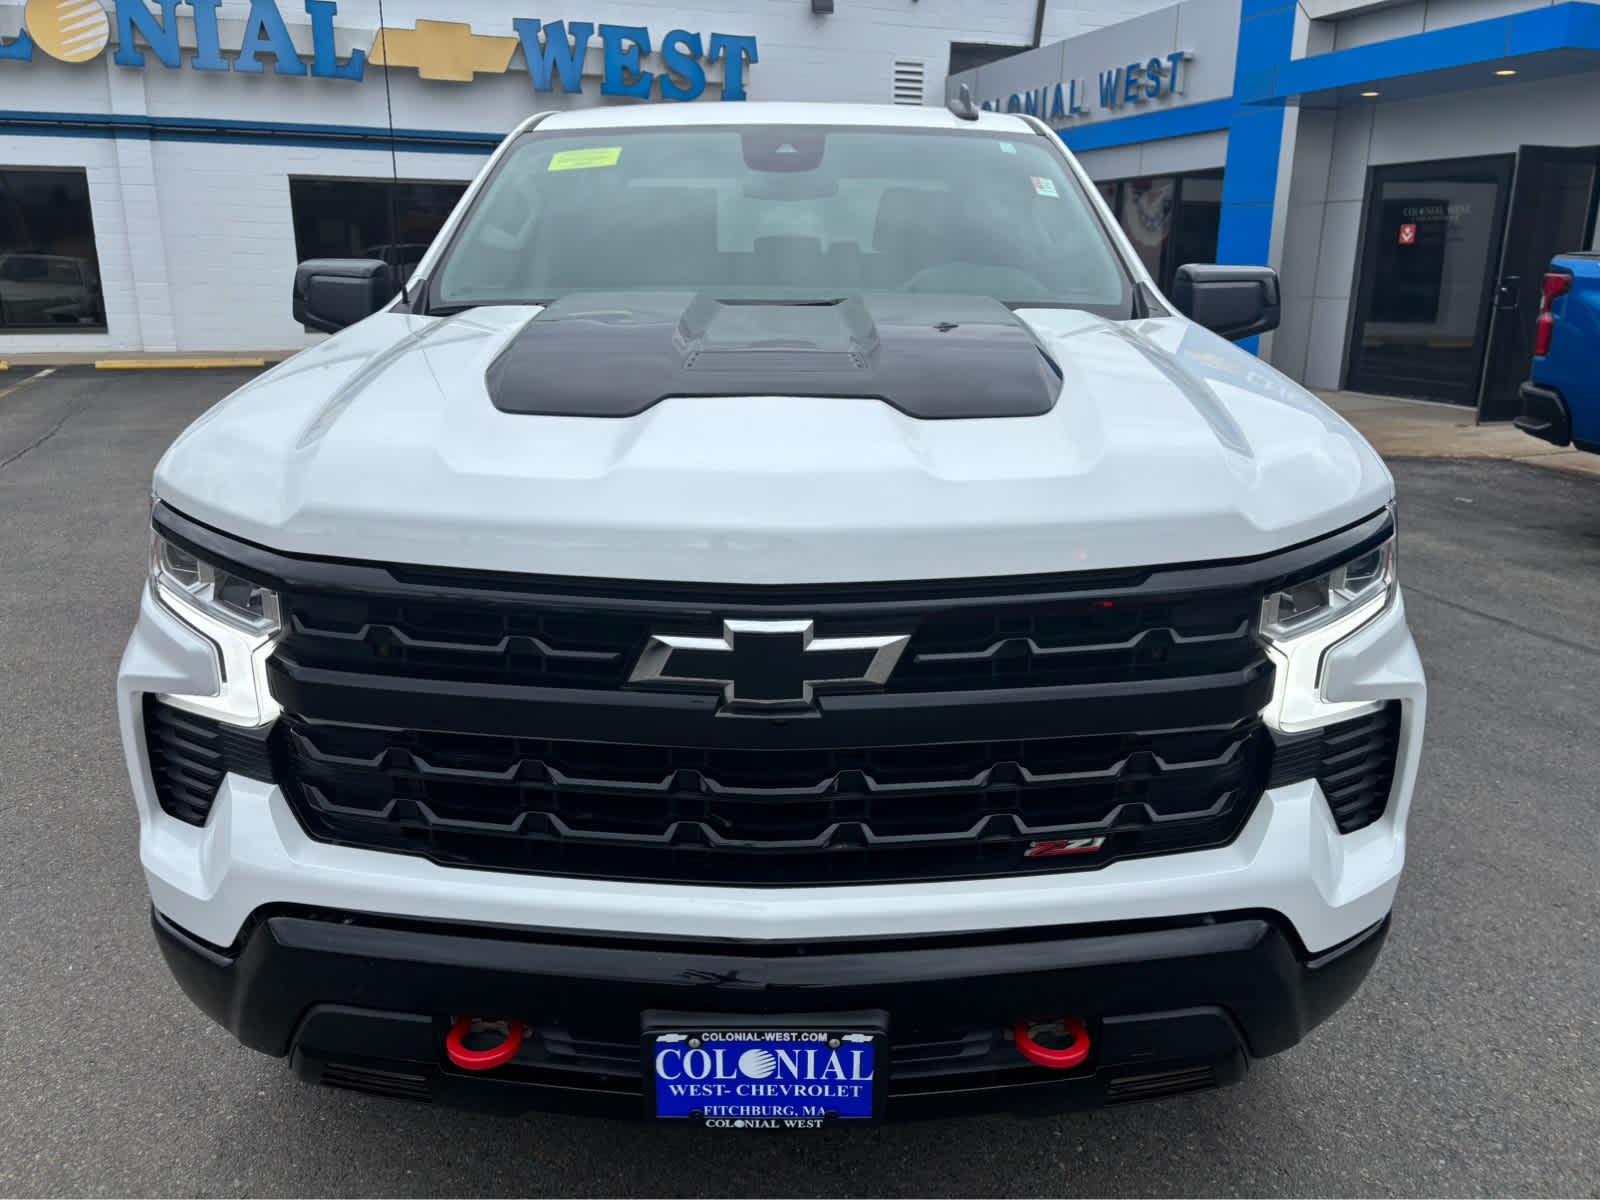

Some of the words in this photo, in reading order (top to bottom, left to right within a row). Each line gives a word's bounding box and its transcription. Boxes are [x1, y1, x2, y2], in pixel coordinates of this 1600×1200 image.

[512, 17, 759, 102] WEST
[1099, 51, 1187, 109] WEST
[1024, 837, 1106, 857] Z71
[702, 1032, 828, 1042] COLONIAL-WEST.COM
[656, 1049, 874, 1080] COLONIAL
[669, 1084, 731, 1097] WEST-
[736, 1084, 864, 1098] CHEVROLET
[704, 1105, 799, 1117] FITCHBURG,
[802, 1106, 825, 1116] MA
[705, 1119, 780, 1128] COLONIAL
[784, 1119, 824, 1128] WEST
